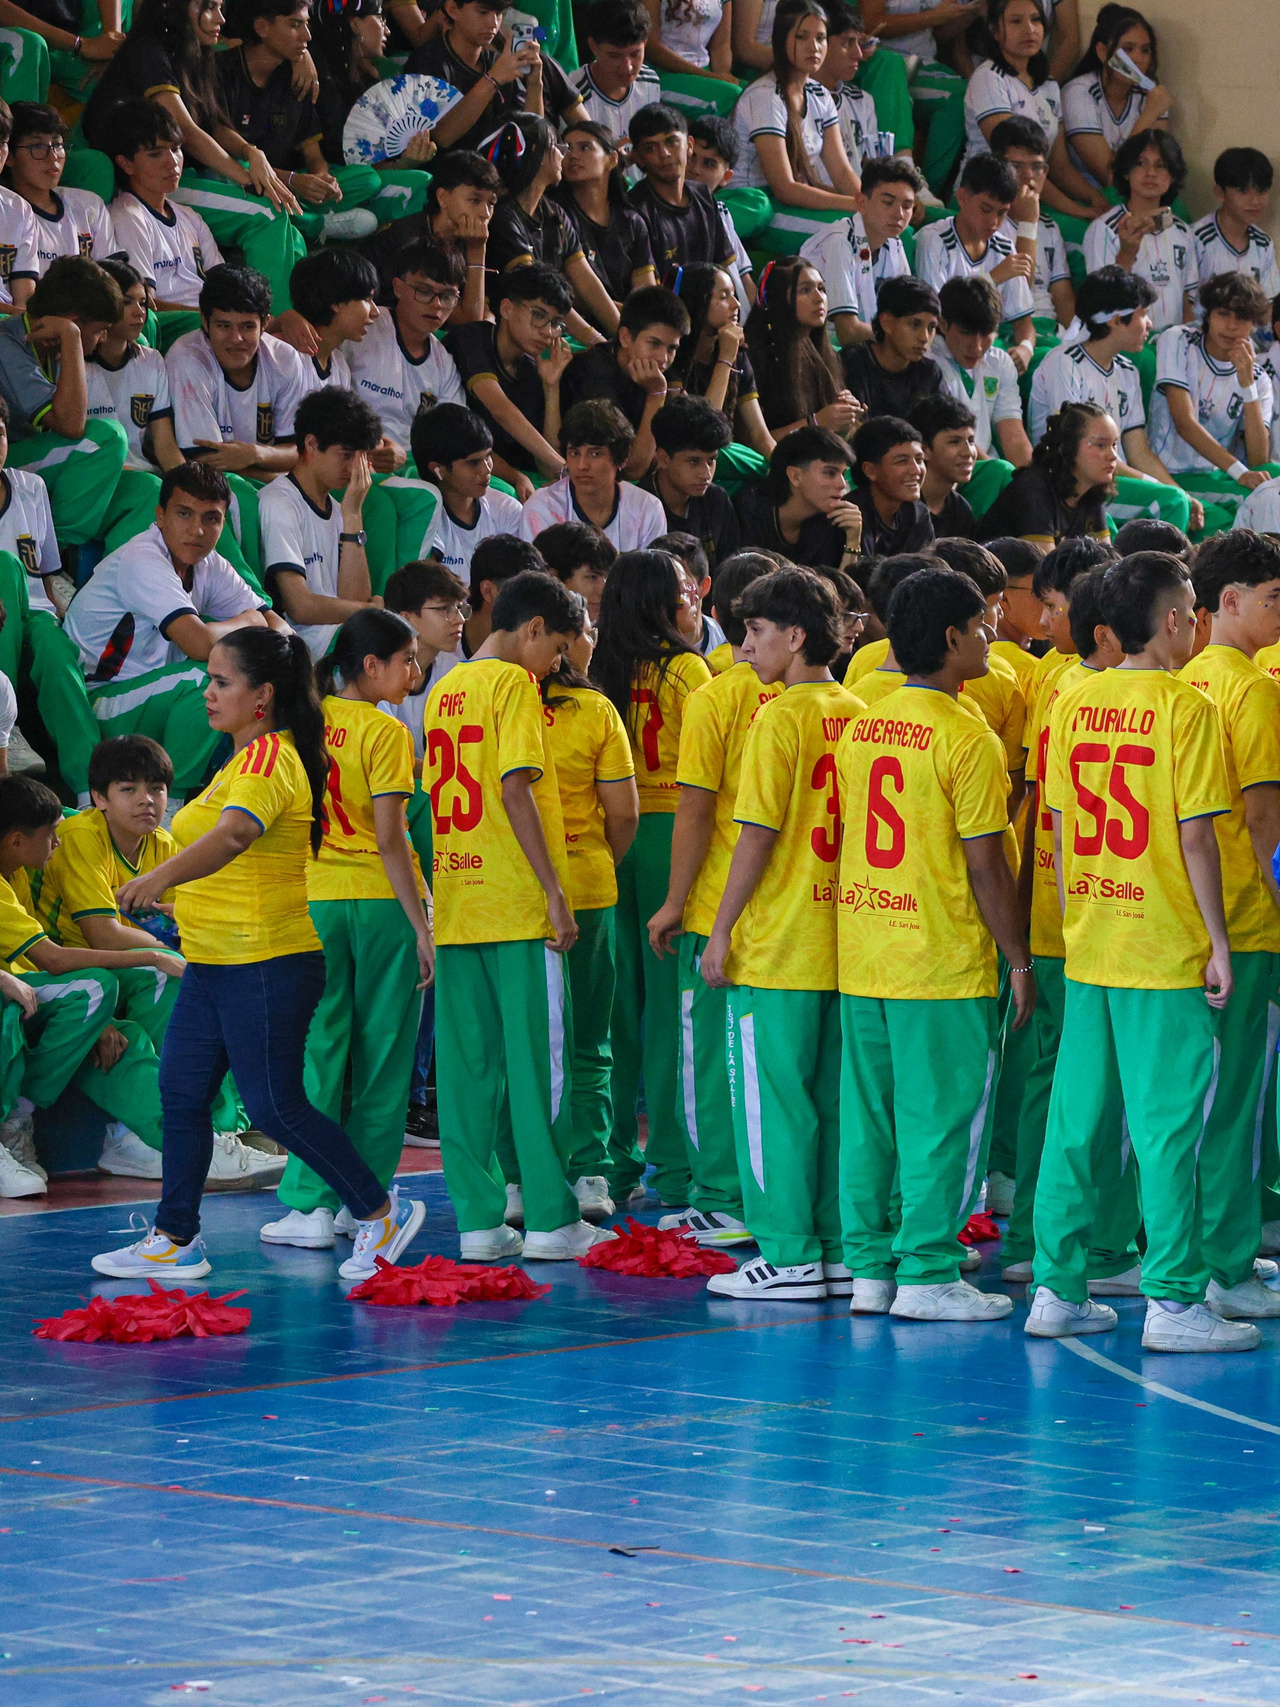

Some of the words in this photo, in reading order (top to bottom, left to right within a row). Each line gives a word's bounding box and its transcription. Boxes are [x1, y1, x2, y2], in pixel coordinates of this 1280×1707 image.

[438, 690, 467, 718] PIPE
[852, 718, 934, 751] GUERRERO
[1072, 705, 1156, 736] MURILLO
[427, 724, 484, 835] 25
[864, 755, 906, 869] 6
[1069, 742, 1156, 860] 55
[449, 851, 483, 871] Salle
[877, 889, 918, 913] Salle
[1099, 877, 1145, 902] Salle
